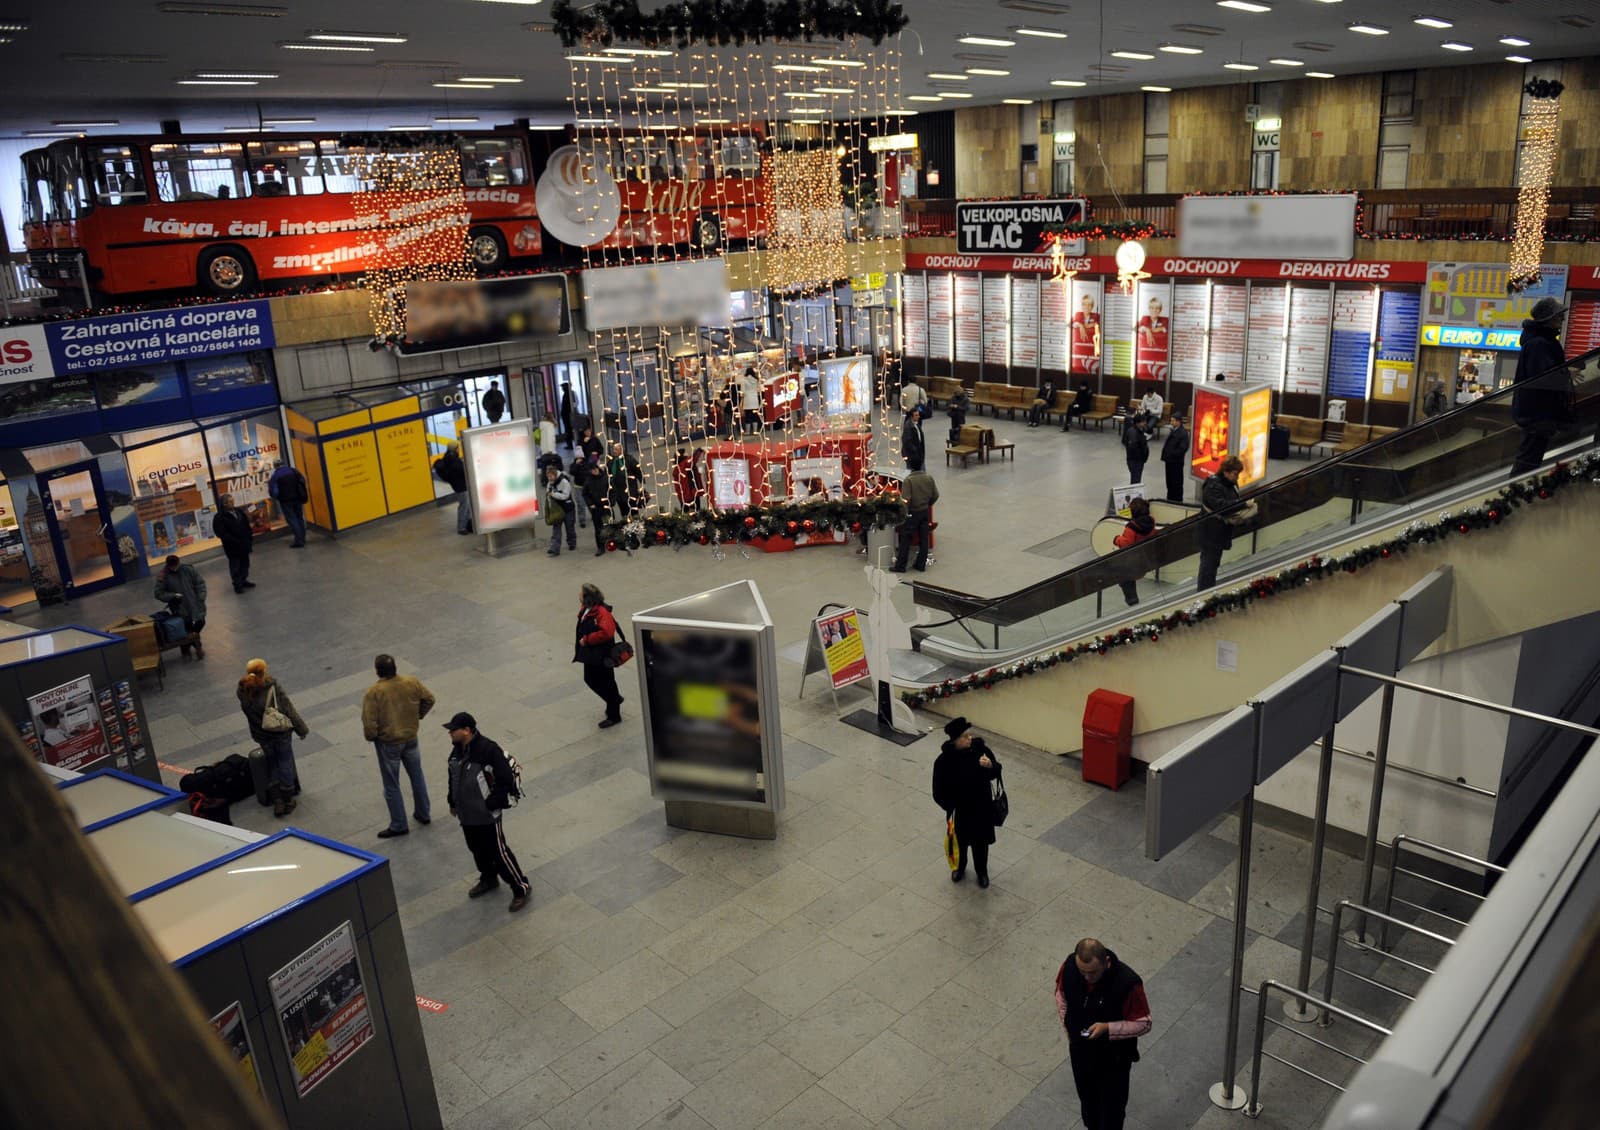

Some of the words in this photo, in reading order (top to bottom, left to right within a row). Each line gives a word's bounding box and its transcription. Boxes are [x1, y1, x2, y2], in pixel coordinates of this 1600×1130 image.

[1057, 144, 1076, 156] WC
[1257, 133, 1279, 147] WC
[142, 217, 221, 238] káva,
[228, 218, 274, 238] čaj,
[962, 222, 1023, 249] TLAČ
[925, 255, 981, 269] ODCHODY
[1163, 259, 1241, 274] ODCHODY
[1279, 261, 1391, 279] DEPARTURES
[60, 312, 177, 341] Zahraničná
[180, 307, 258, 329] doprava
[64, 333, 161, 359] Cestovná
[165, 321, 261, 347] kancelária
[1441, 328, 1483, 346] EURO
[67, 360, 87, 370] tel.:
[88, 353, 137, 368] 02/5542
[140, 349, 167, 360] 1667
[170, 347, 190, 357] fax:
[238, 336, 262, 347] 1404
[229, 442, 278, 462] eurobus
[148, 459, 202, 481] eurobus
